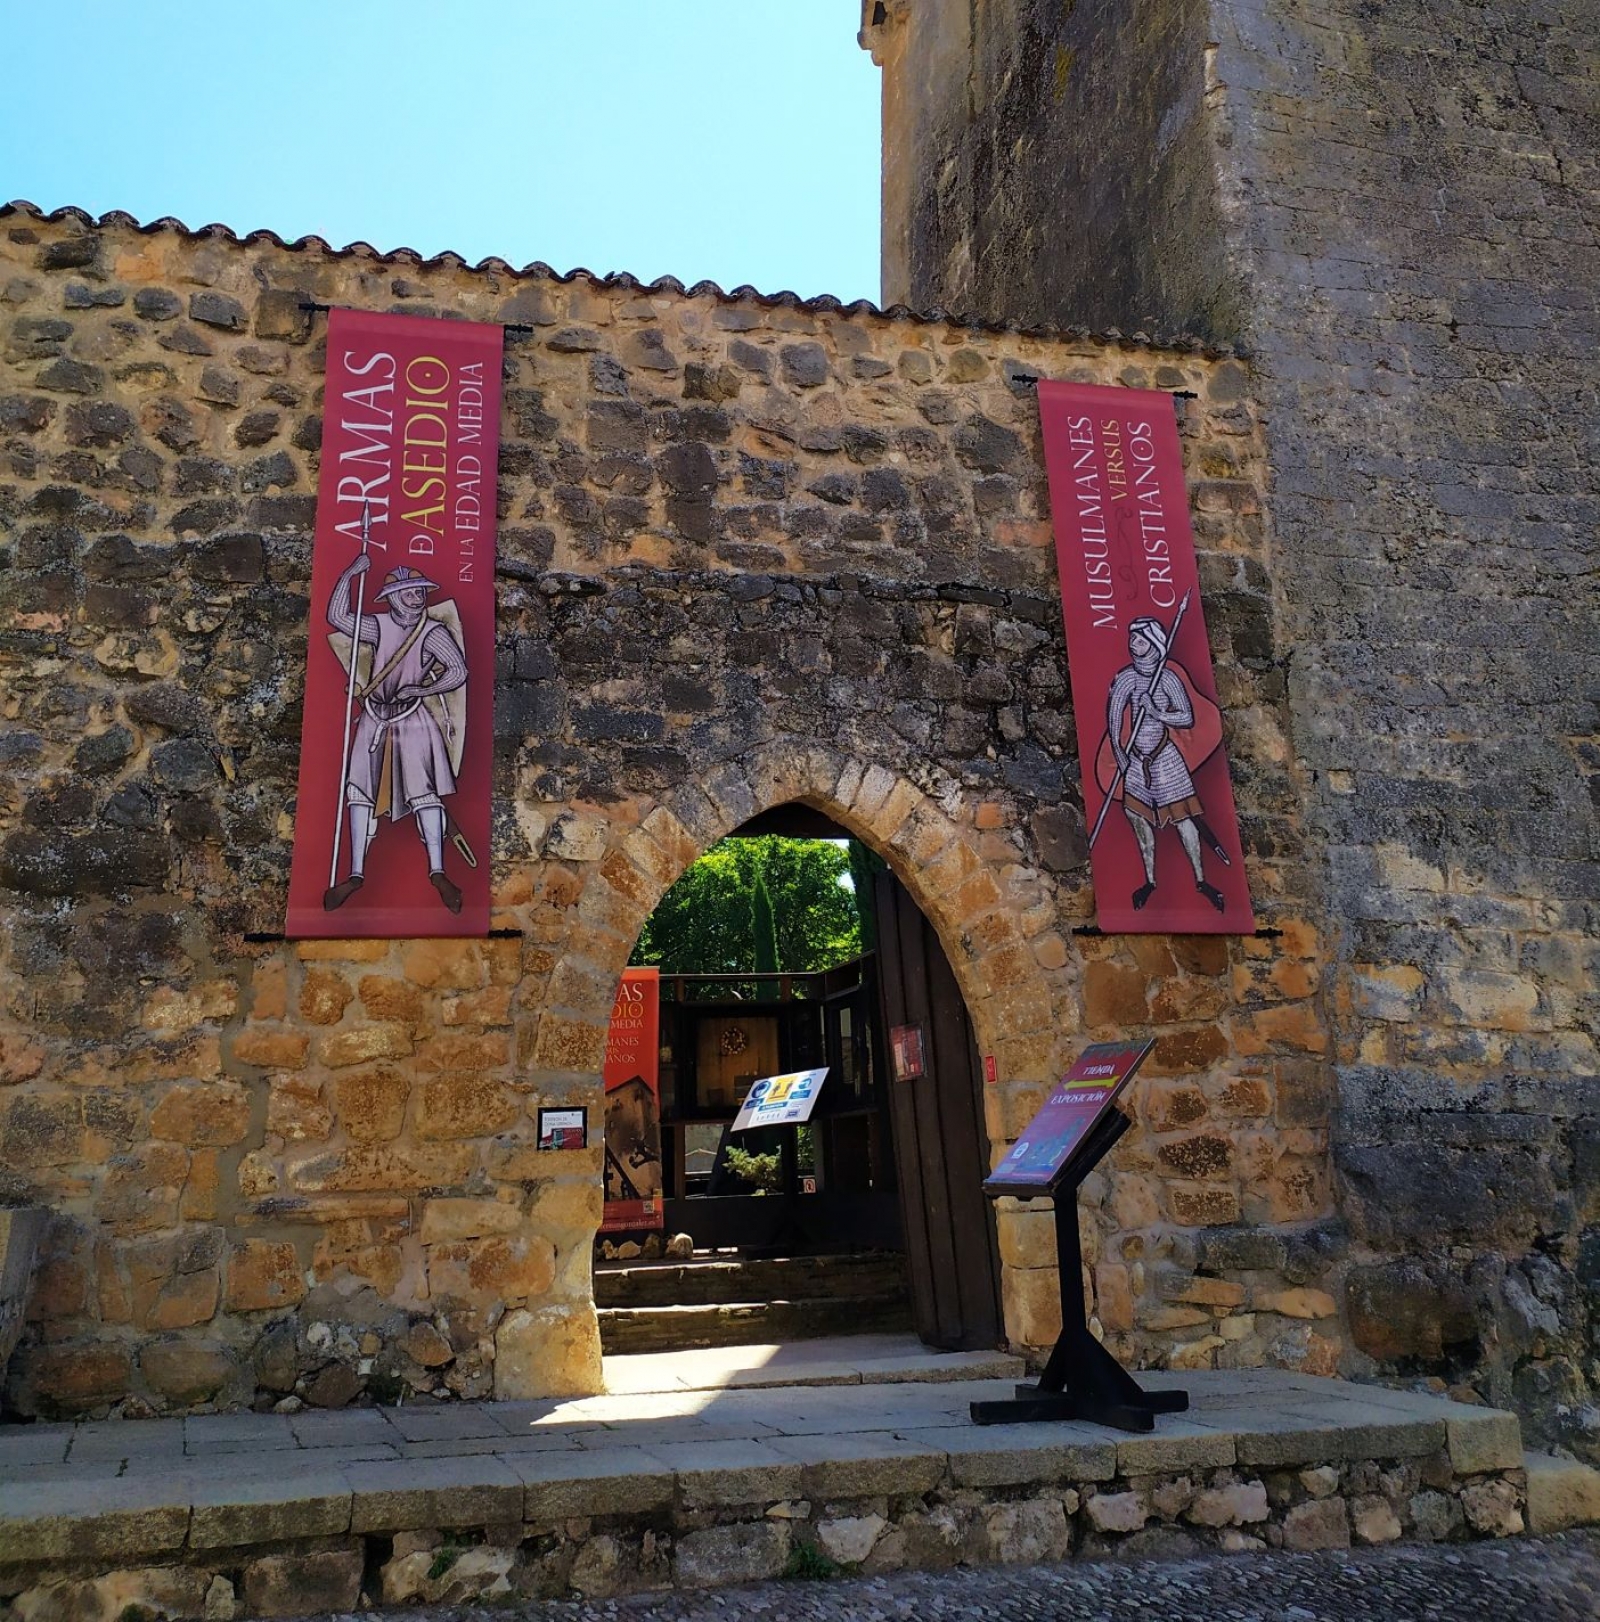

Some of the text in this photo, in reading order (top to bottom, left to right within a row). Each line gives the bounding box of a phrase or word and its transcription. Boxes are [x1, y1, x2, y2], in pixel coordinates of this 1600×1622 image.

[334, 351, 397, 553] ARMAS
[400, 355, 451, 537] ASEDIO
[455, 362, 484, 583] EN LA EDAD MEDIA
[1067, 416, 1118, 629] MUSULMANES
[1100, 419, 1128, 502] VERSUS
[1126, 421, 1176, 608] CRISTIANOS
[610, 1019, 643, 1029] MEDIA
[1050, 1090, 1107, 1105] EXPOSICIÓN
[1082, 1064, 1116, 1076] TIENDA
